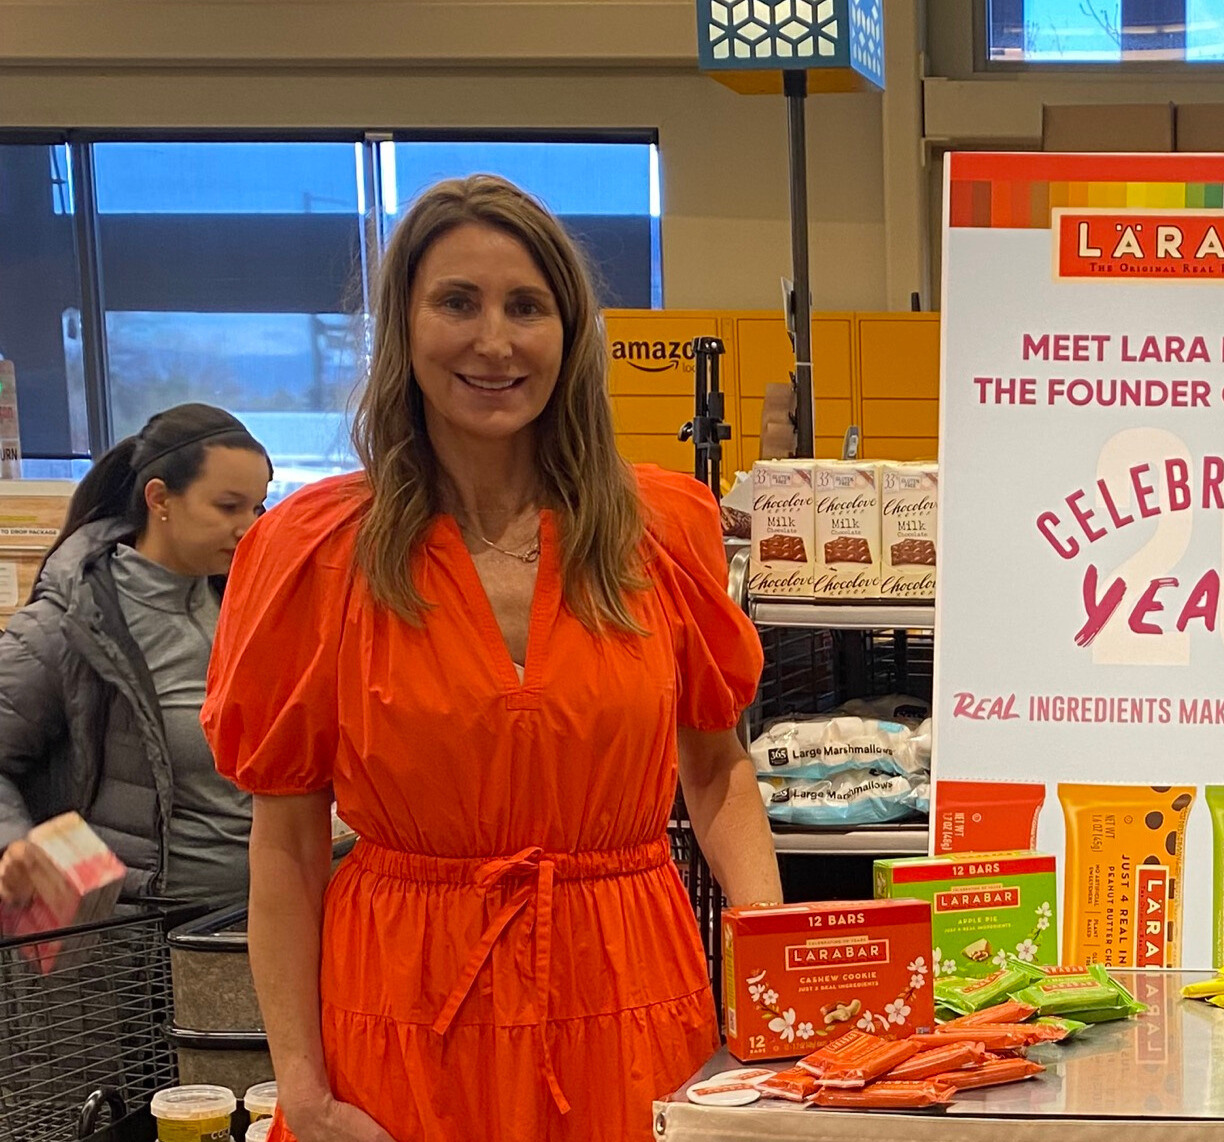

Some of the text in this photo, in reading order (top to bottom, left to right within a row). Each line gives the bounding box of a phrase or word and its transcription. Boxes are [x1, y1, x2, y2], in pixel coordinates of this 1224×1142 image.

[612, 340, 695, 360] amazo
[1022, 334, 1111, 362] MEET
[1121, 335, 1211, 363] LARA
[973, 377, 1037, 405] THE
[1048, 378, 1211, 407] FOUNDER
[753, 492, 813, 511] Chocolove
[816, 493, 876, 514] Chocolove
[883, 495, 937, 516] Chocolov
[767, 516, 796, 527] Milk
[831, 518, 860, 529] Milk
[897, 520, 926, 531] Milk
[749, 570, 814, 590] Chocolove
[813, 571, 879, 593] Chocolove
[953, 691, 1020, 722] REAL
[1029, 696, 1172, 724] INGREDIENTS
[792, 748, 822, 759] Large
[794, 789, 824, 799] Large
[952, 863, 1000, 876] 12 BARS
[1105, 866, 1115, 945] PEANUT BUTTER
[1119, 854, 1130, 944] JUST 4 REAL
[808, 913, 865, 927] 12 BARS
[957, 915, 998, 925] APPLE PIE
[799, 971, 877, 985] CASHEW COOKIE
[749, 1035, 766, 1048] 12
